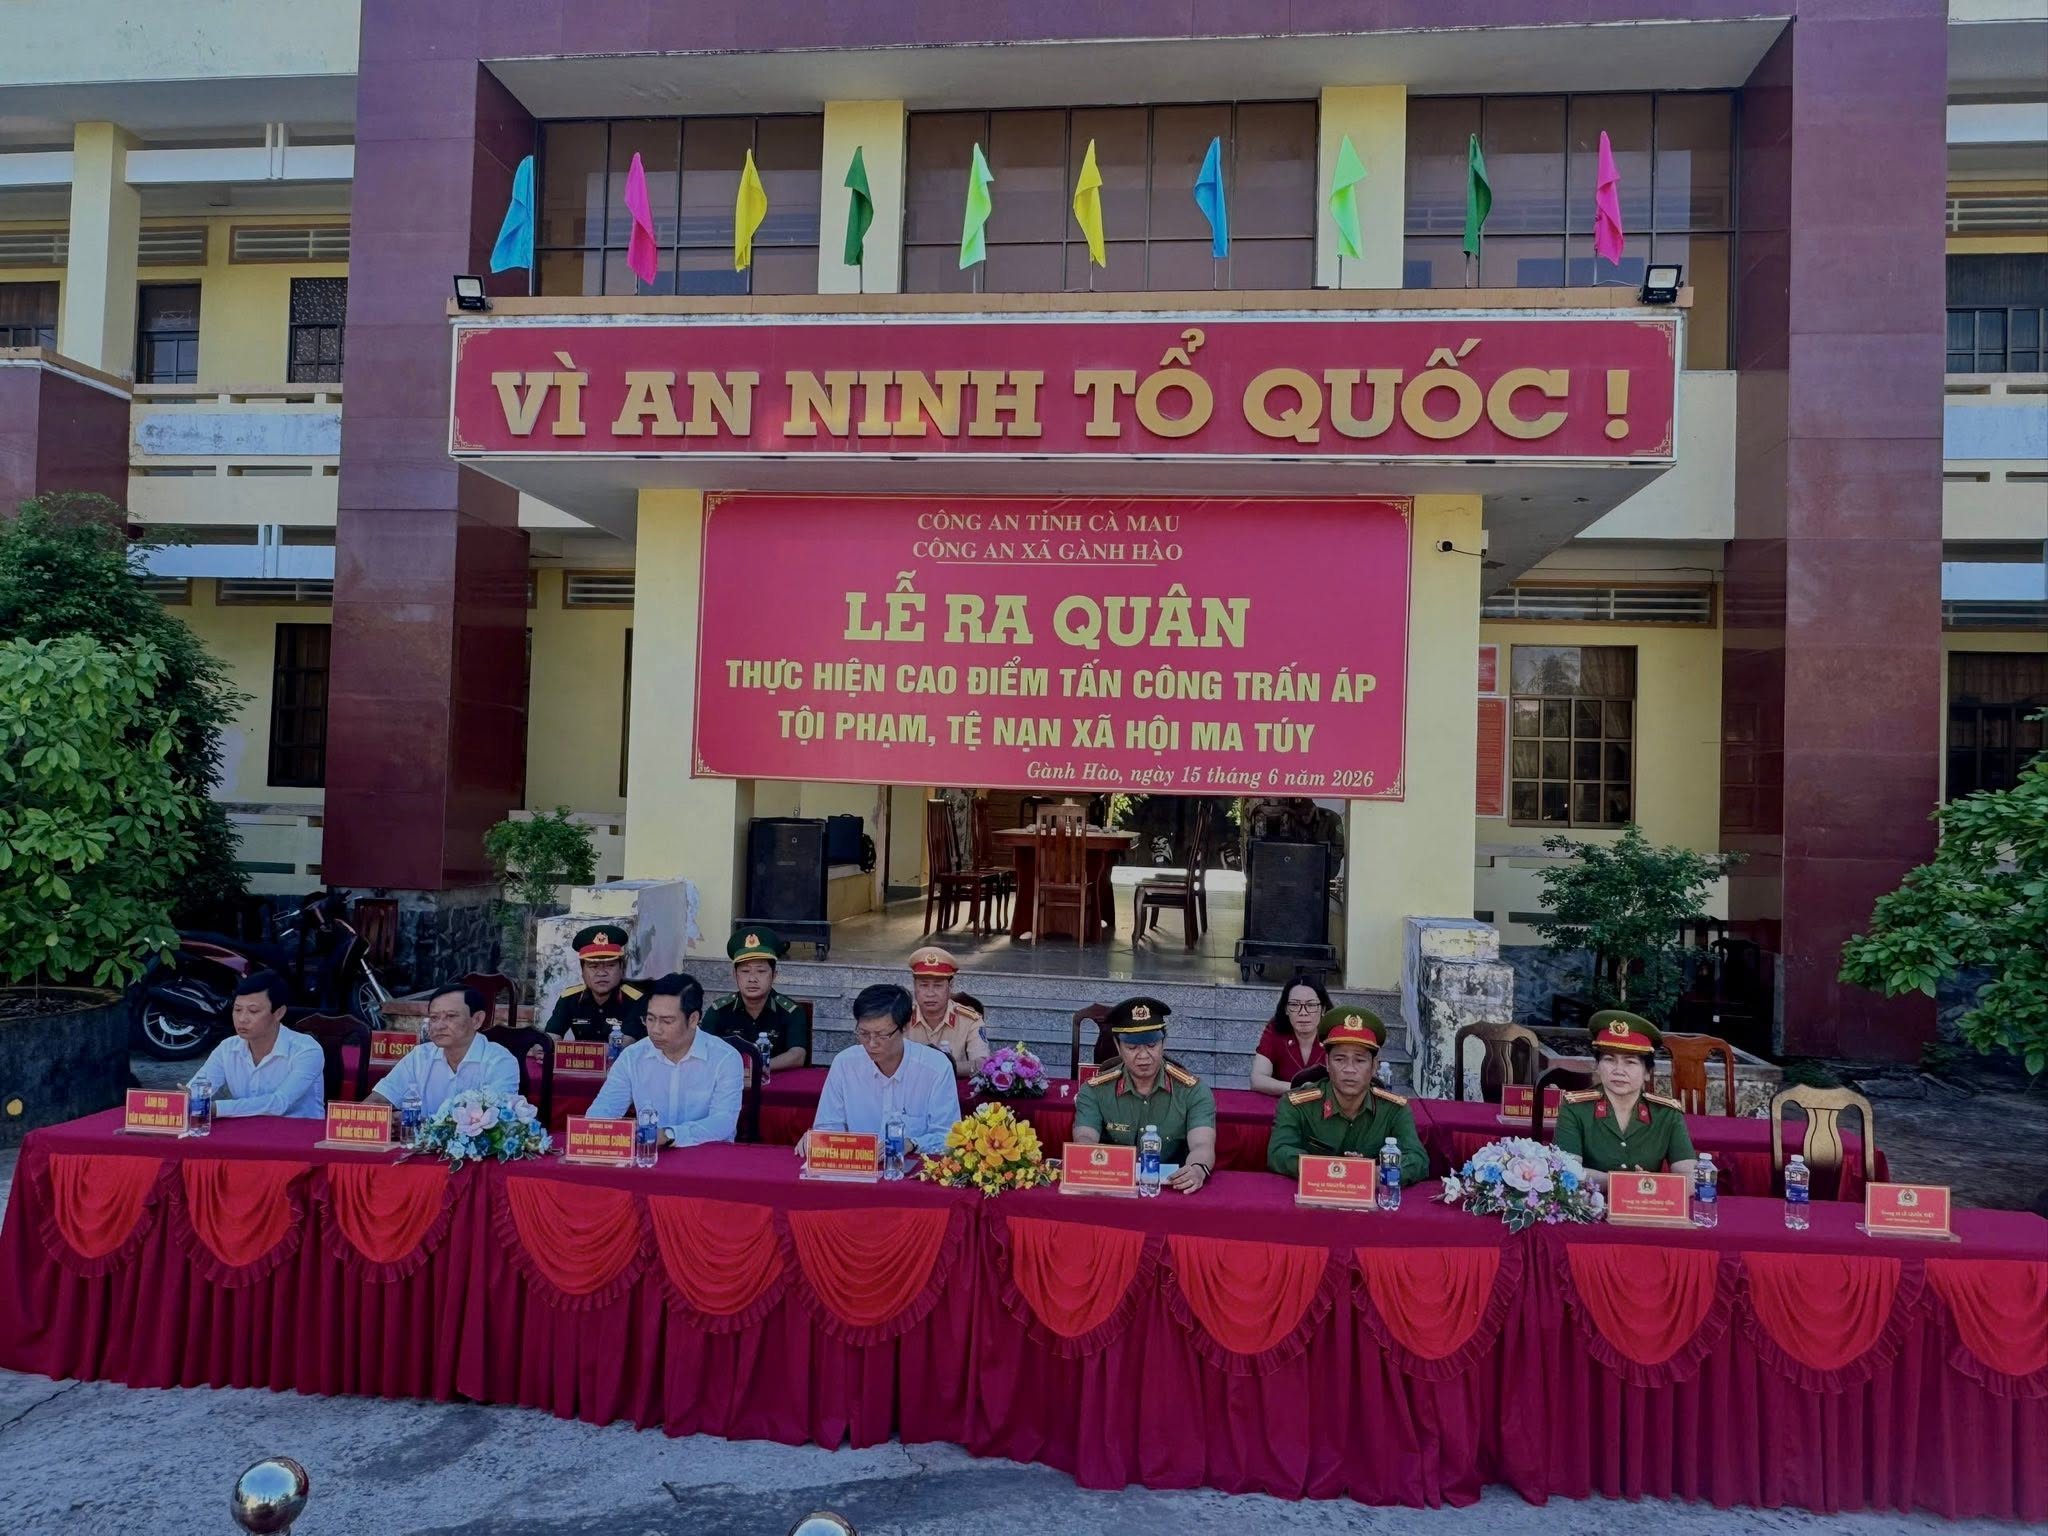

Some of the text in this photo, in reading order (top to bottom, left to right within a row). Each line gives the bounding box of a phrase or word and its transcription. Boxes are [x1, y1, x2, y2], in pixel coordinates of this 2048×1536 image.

[491, 328, 1630, 443] VÌ AN NINH TỔ QUỐC !
[917, 508, 1180, 532] CÔNG AN TỈNH CÀ MAU
[912, 537, 1183, 561] CÔNG AN XÃ GÀNH HÀO
[843, 569, 1251, 650] LỄ RA QUÂN
[726, 655, 1377, 703] THỰC HIỆN CAO ĐIỂM TẤN CÔNG TRẤN ÁP
[778, 704, 1315, 756] TỘI PHẠM, TỆ NẠN XÃ HỘI MA TÚY
[1027, 761, 1375, 788] Gành Hào, ngày 15 tháng 6 năm 2026
[373, 1038, 387, 1054] TỔ
